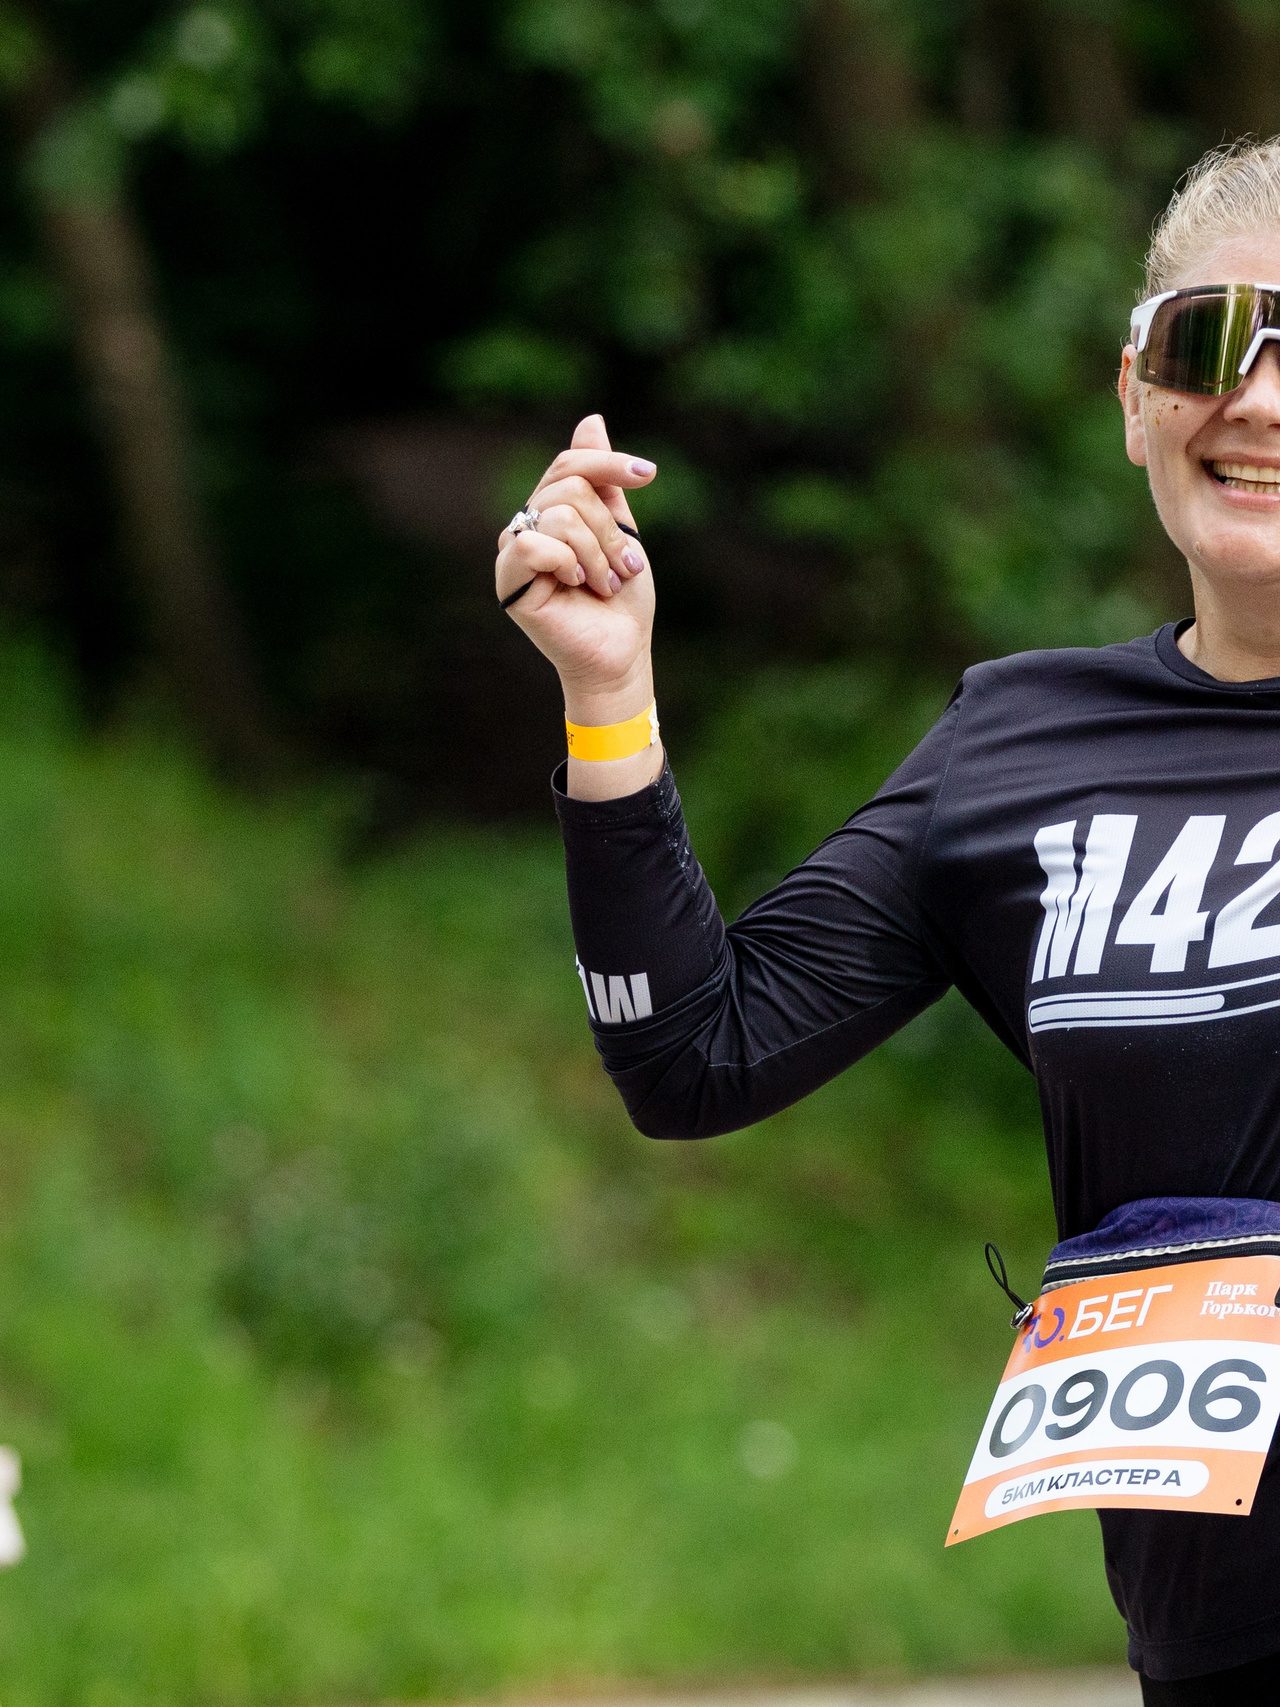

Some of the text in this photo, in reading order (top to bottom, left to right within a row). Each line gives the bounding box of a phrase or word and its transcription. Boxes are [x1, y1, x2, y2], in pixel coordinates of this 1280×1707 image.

[1205, 1281, 1258, 1300] Парк
[989, 1358, 1267, 1458] 0906
[1001, 1468, 1182, 1506] 5КМ КЛАСТЕР А
